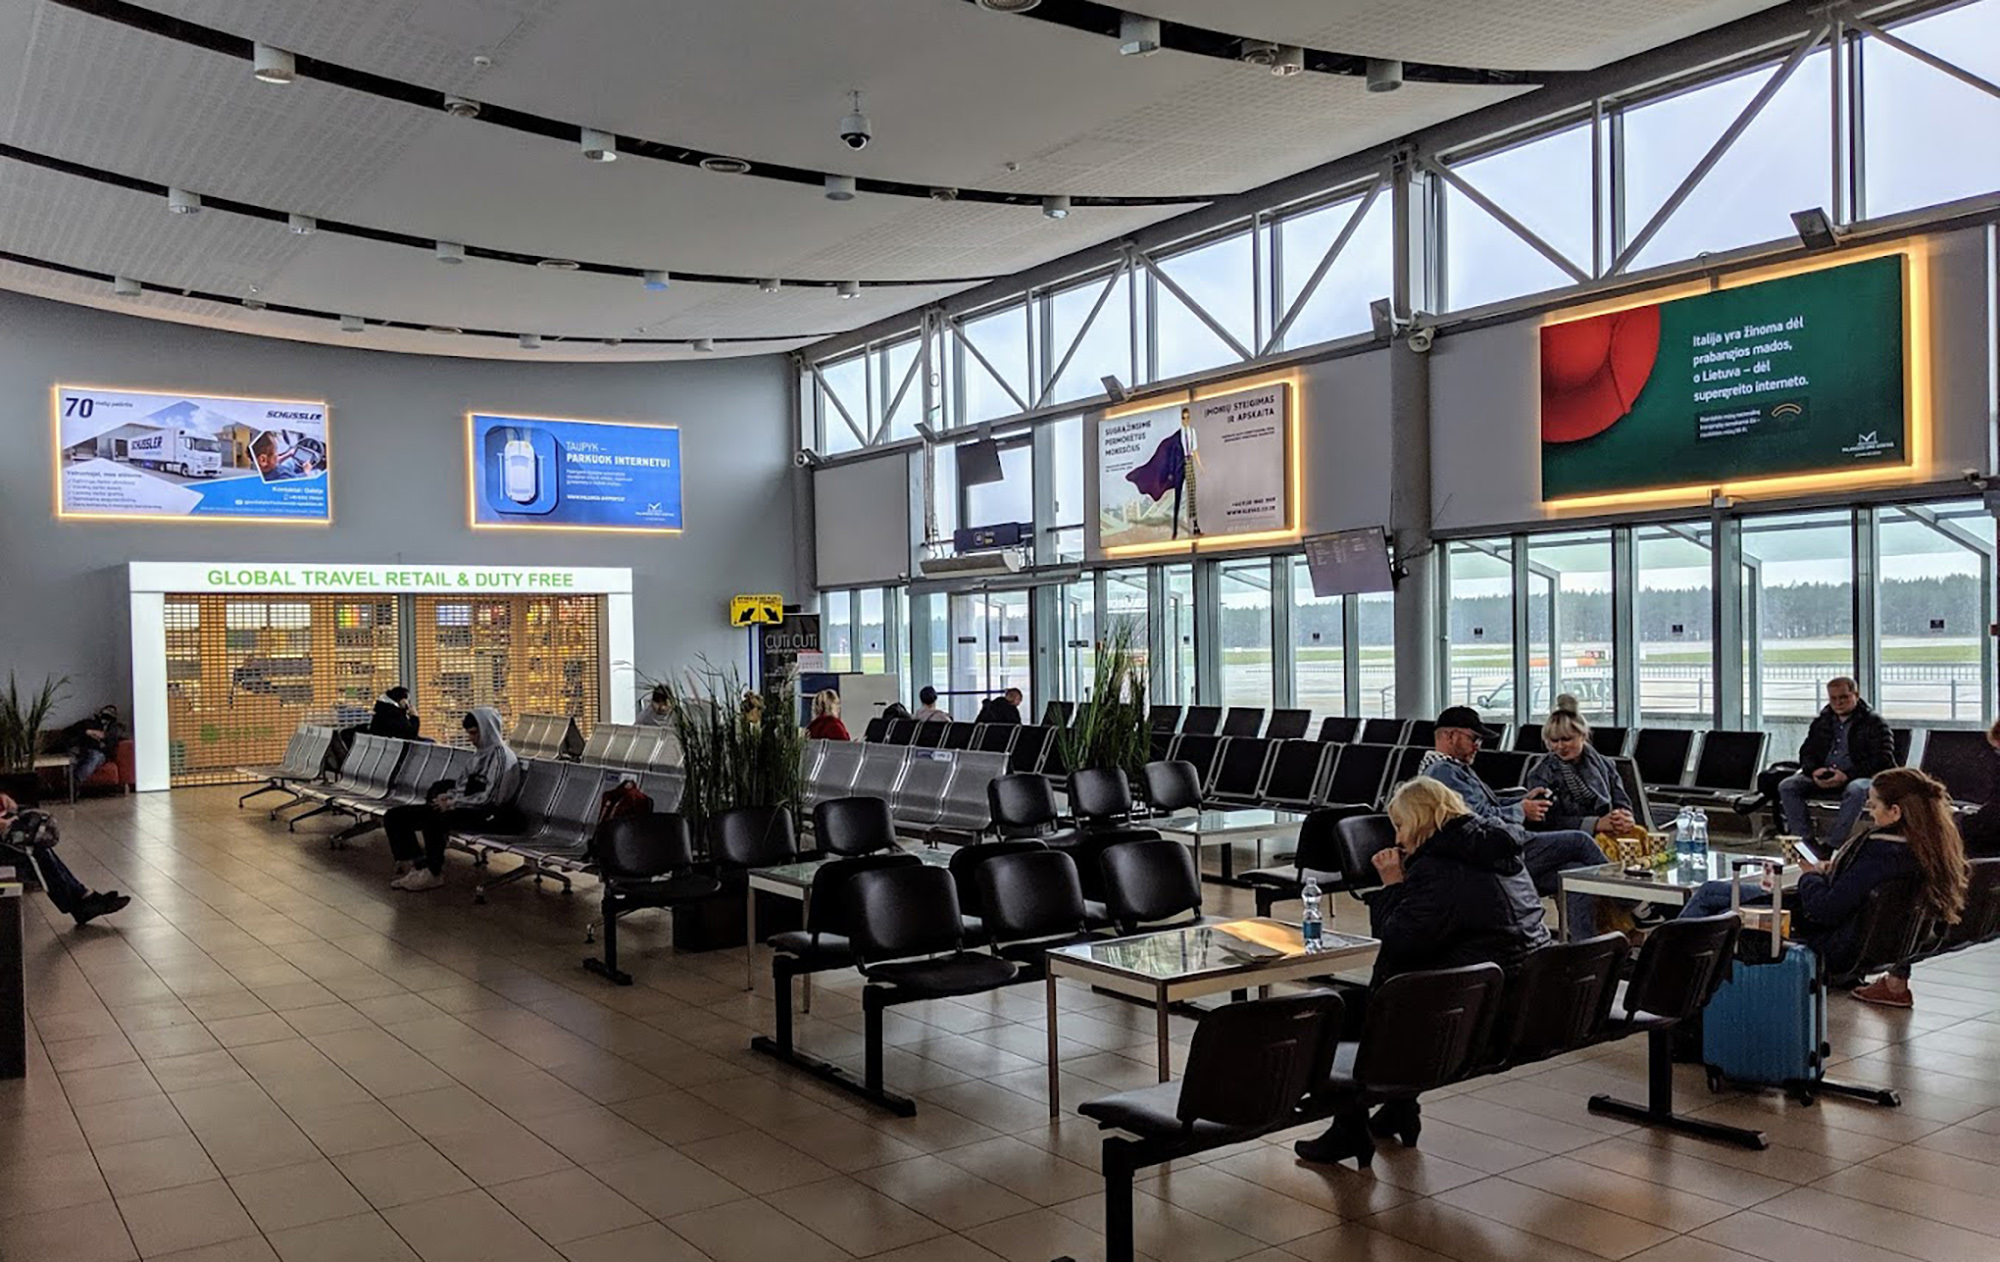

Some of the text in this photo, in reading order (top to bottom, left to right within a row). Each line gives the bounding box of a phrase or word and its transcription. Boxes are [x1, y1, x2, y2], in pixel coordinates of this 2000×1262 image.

[1693, 315, 1804, 347] Italija yra žinoma dėl
[1693, 340, 1793, 368] prabangios mados,
[1693, 374, 1700, 384] o
[1702, 367, 1741, 382] Lietuva
[1753, 359, 1771, 374] dėl
[1693, 375, 1810, 403] supergreito interneto.
[65, 397, 94, 419] 70
[1233, 395, 1275, 411] STEIGIMAS
[1227, 408, 1275, 424] IR APSKAITA
[565, 441, 599, 453] TAUPYK
[566, 453, 671, 469] PARKUOK INTERNETU!
[207, 569, 574, 588] GLOBAL TRAVEL RETAIL & DUTY FREE
